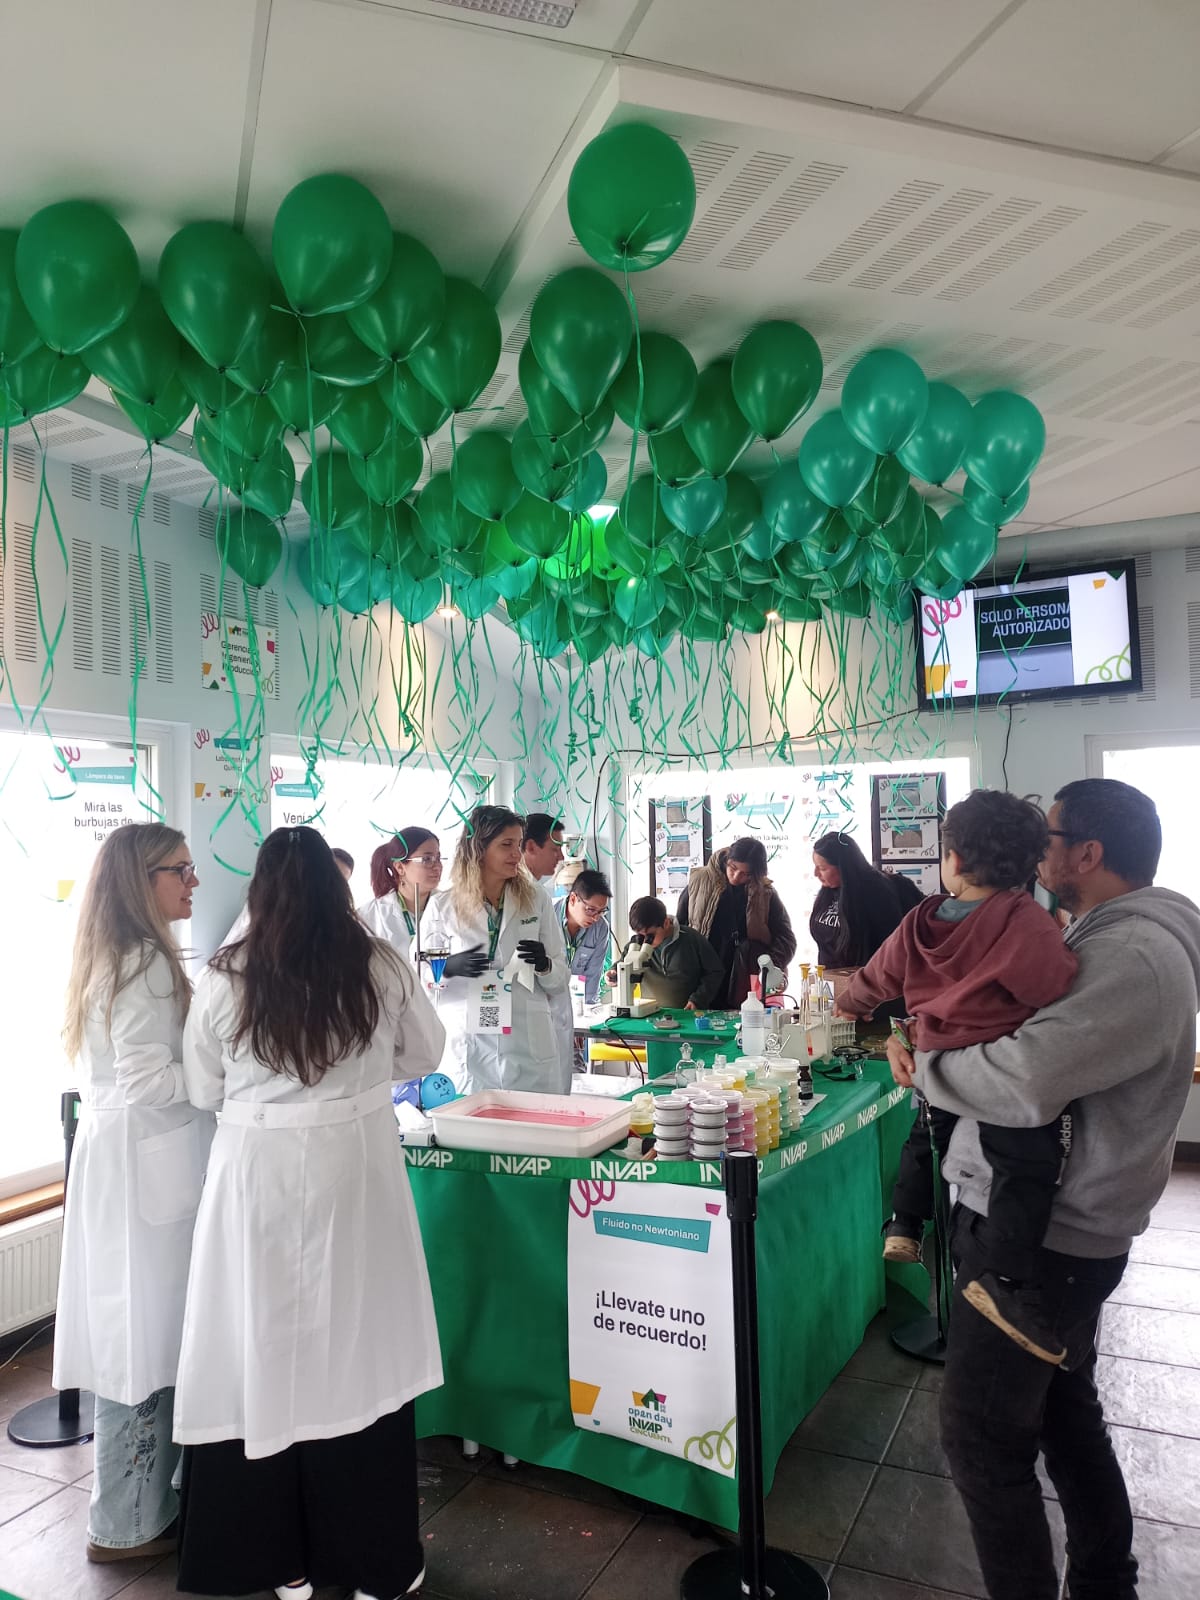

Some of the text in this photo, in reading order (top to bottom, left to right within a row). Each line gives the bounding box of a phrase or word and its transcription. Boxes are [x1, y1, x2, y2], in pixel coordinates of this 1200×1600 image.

[981, 609, 1012, 624] SOLO
[992, 617, 1070, 638] AUTORIZADO
[84, 802, 123, 813] Mirá las
[74, 816, 119, 829] burbujas
[857, 1103, 878, 1129] INVAP
[821, 1122, 846, 1150] INVAP
[404, 1148, 454, 1169] NVAP
[490, 1154, 552, 1176] INVAP
[780, 1141, 808, 1169] INVAP
[590, 1160, 658, 1181] INVAP
[602, 1217, 700, 1241] Fluido no Newtoniano
[596, 1290, 705, 1326] ¡Llevate uno
[593, 1312, 707, 1351] de recuerdo!
[628, 1415, 663, 1434] INVAP
[654, 1412, 673, 1428] day
